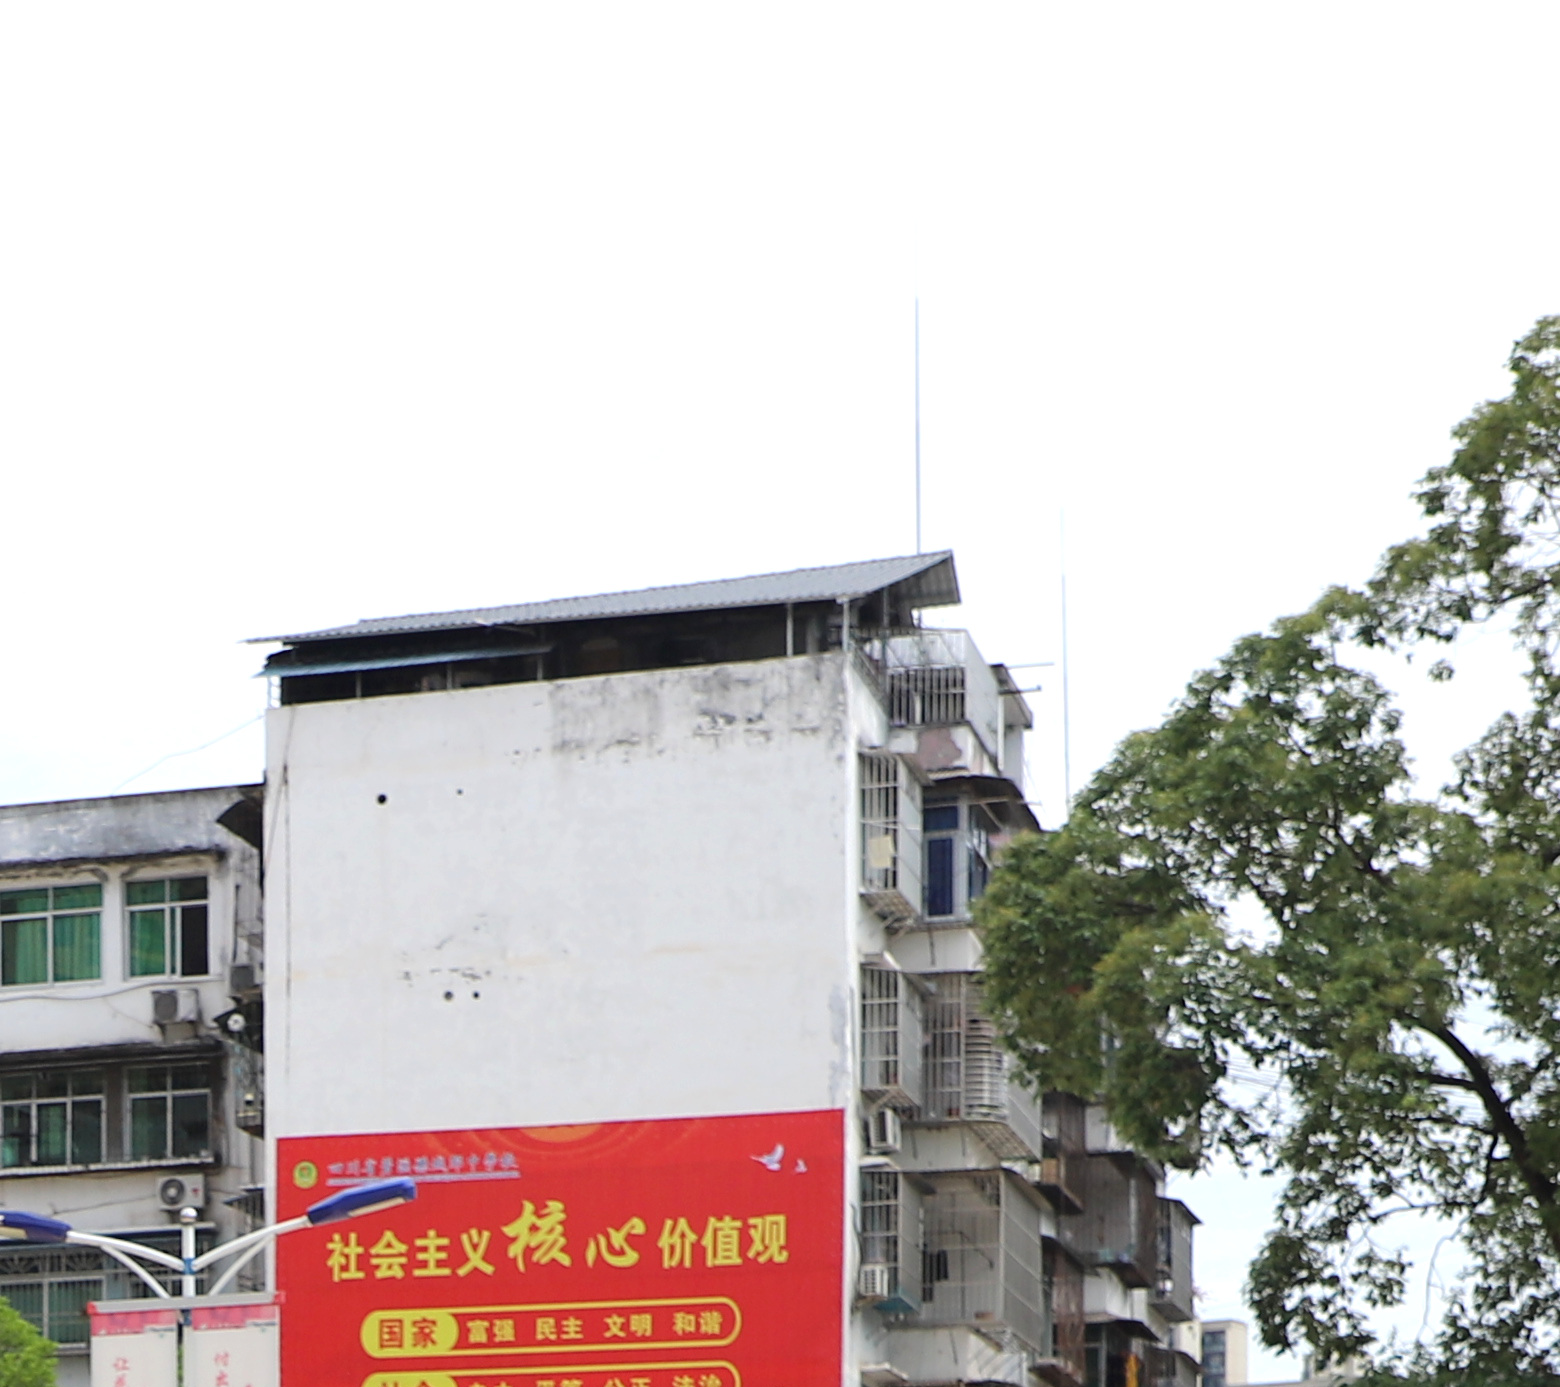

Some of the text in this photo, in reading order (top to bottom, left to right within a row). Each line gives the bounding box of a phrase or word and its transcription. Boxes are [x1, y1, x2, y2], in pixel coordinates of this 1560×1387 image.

[326, 1200, 789, 1282] 社会主义核心价值观
[379, 1309, 723, 1349] 国家 富强 民主 文明 和谐
